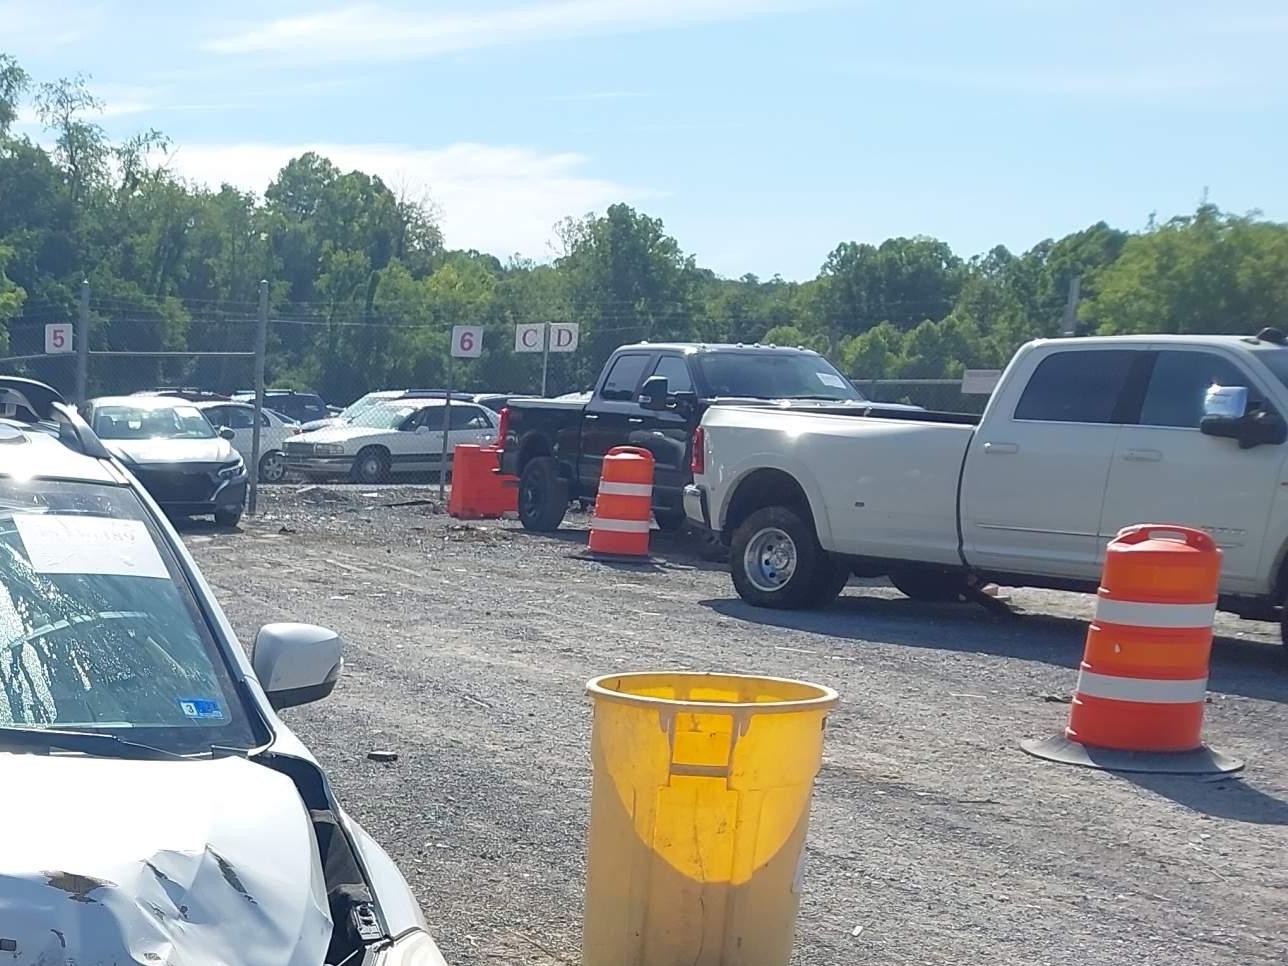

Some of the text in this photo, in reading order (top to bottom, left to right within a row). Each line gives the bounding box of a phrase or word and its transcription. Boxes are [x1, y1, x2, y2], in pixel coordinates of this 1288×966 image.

[52, 329, 65, 348] 5
[460, 331, 474, 352] 6
[522, 328, 573, 347] C D
